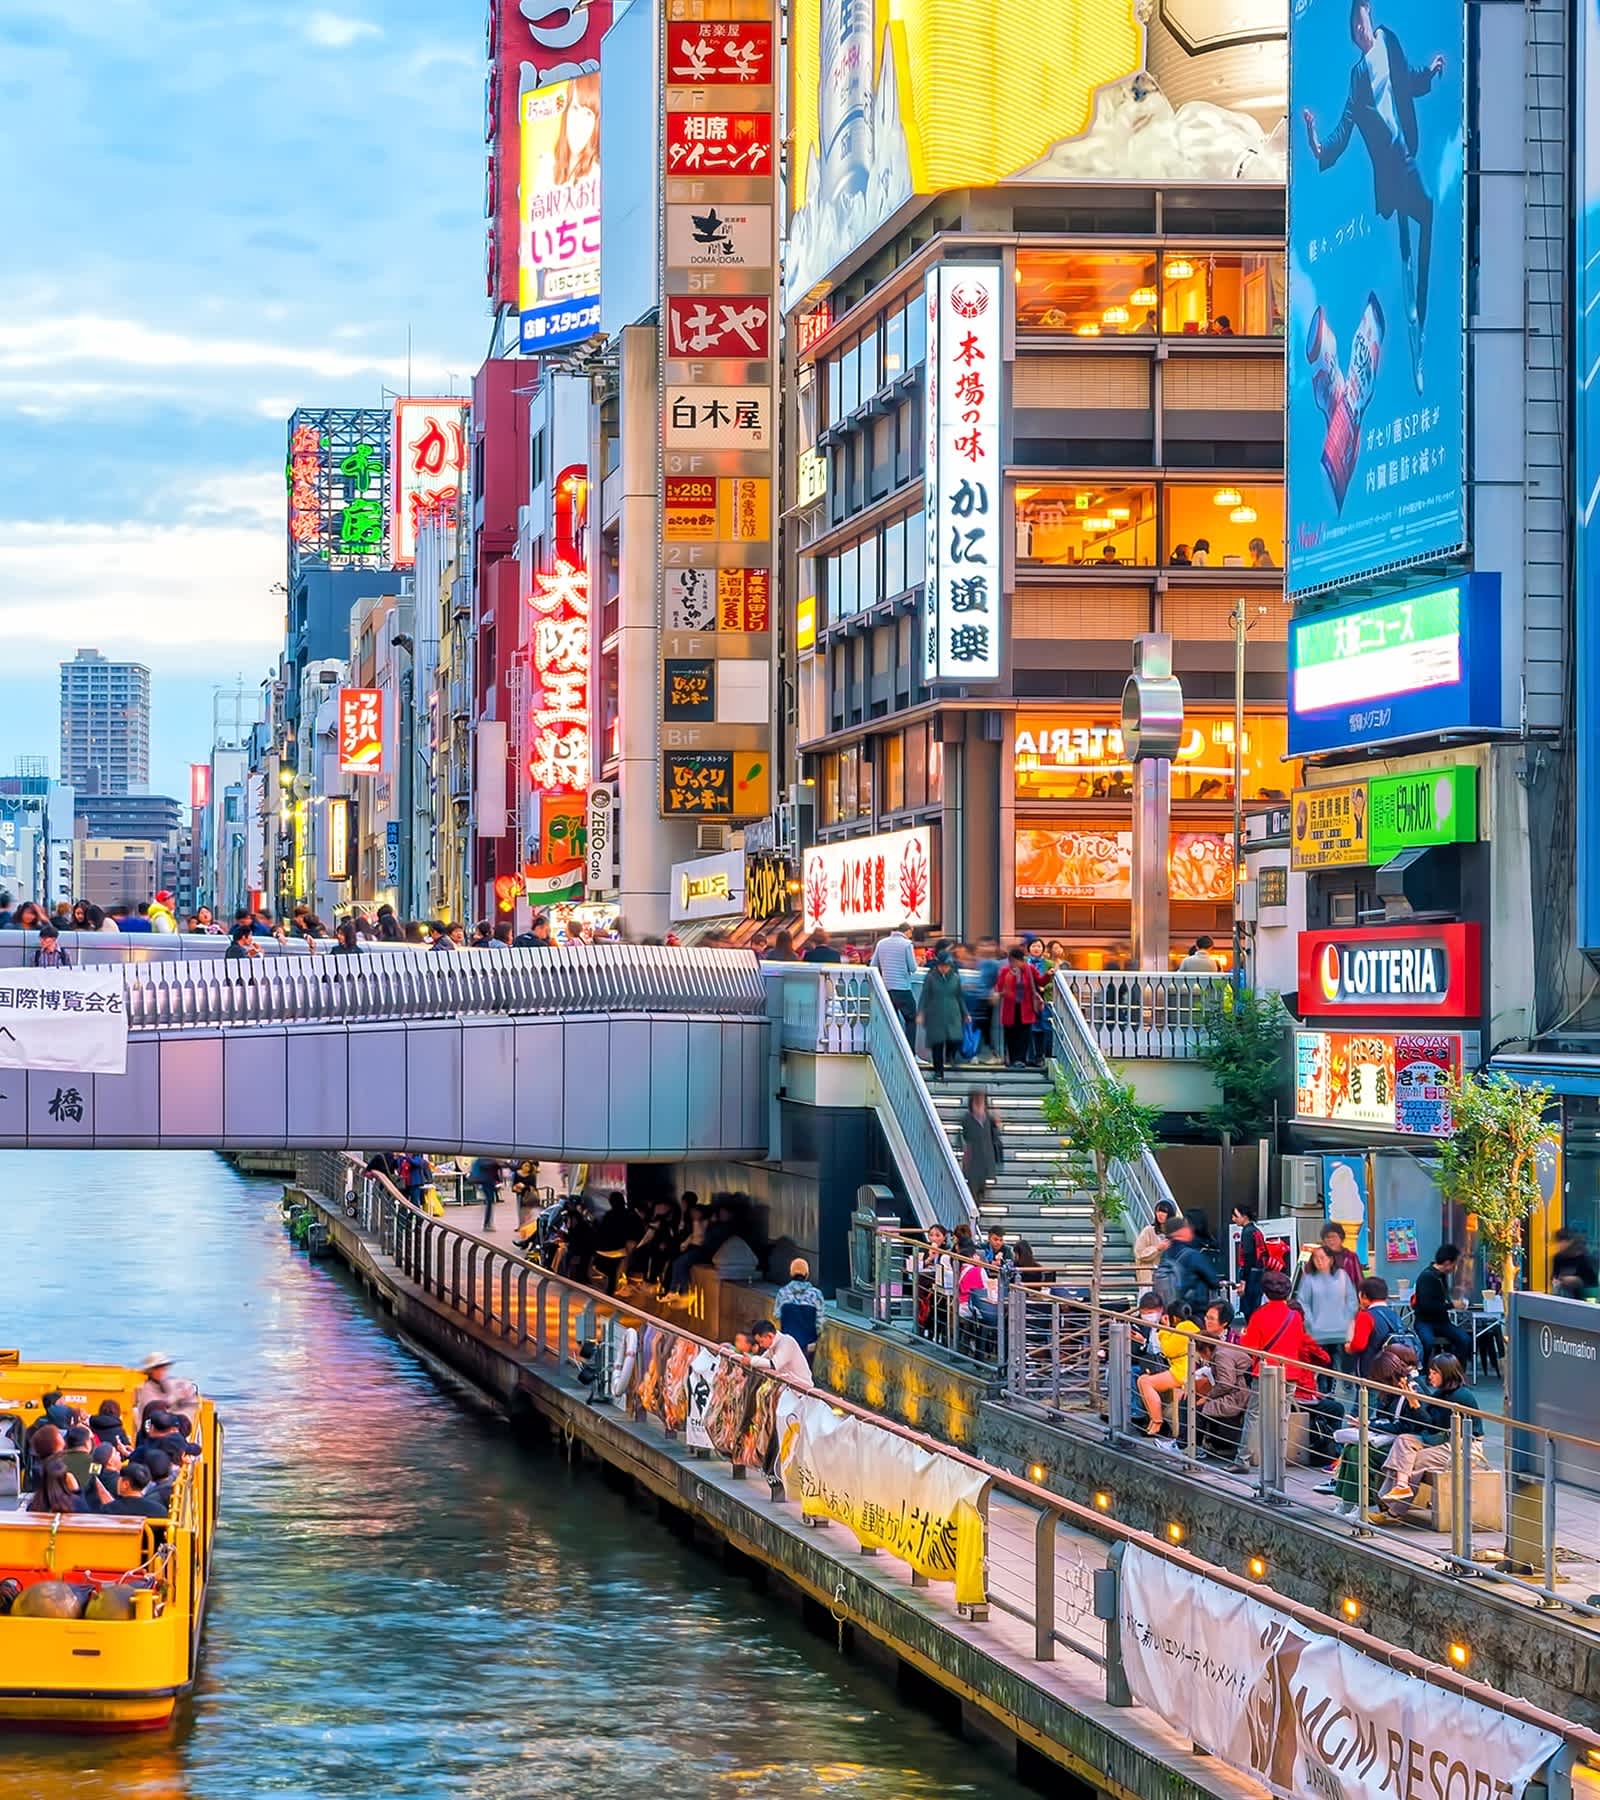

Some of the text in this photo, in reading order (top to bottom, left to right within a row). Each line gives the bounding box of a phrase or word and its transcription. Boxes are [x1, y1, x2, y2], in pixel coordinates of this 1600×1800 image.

[684, 116, 729, 140] 相席
[669, 142, 770, 170] ダイニング
[671, 304, 768, 353] はや
[673, 396, 762, 429] 白木屋
[953, 330, 987, 464] 本場の味
[948, 478, 990, 664] かに道楽
[529, 559, 592, 791] 大阪王将
[672, 676, 707, 691] びっくり
[359, 693, 378, 740] ツルハ
[671, 690, 710, 705] ドンキー
[344, 701, 358, 753] ドラッグ
[672, 765, 726, 788] びっくり
[670, 786, 729, 810] ドンキー
[591, 811, 606, 850] ZERO
[1343, 949, 1437, 993] LOTTERIA
[1552, 1334, 1597, 1361] information
[1295, 1685, 1377, 1780] MGM
